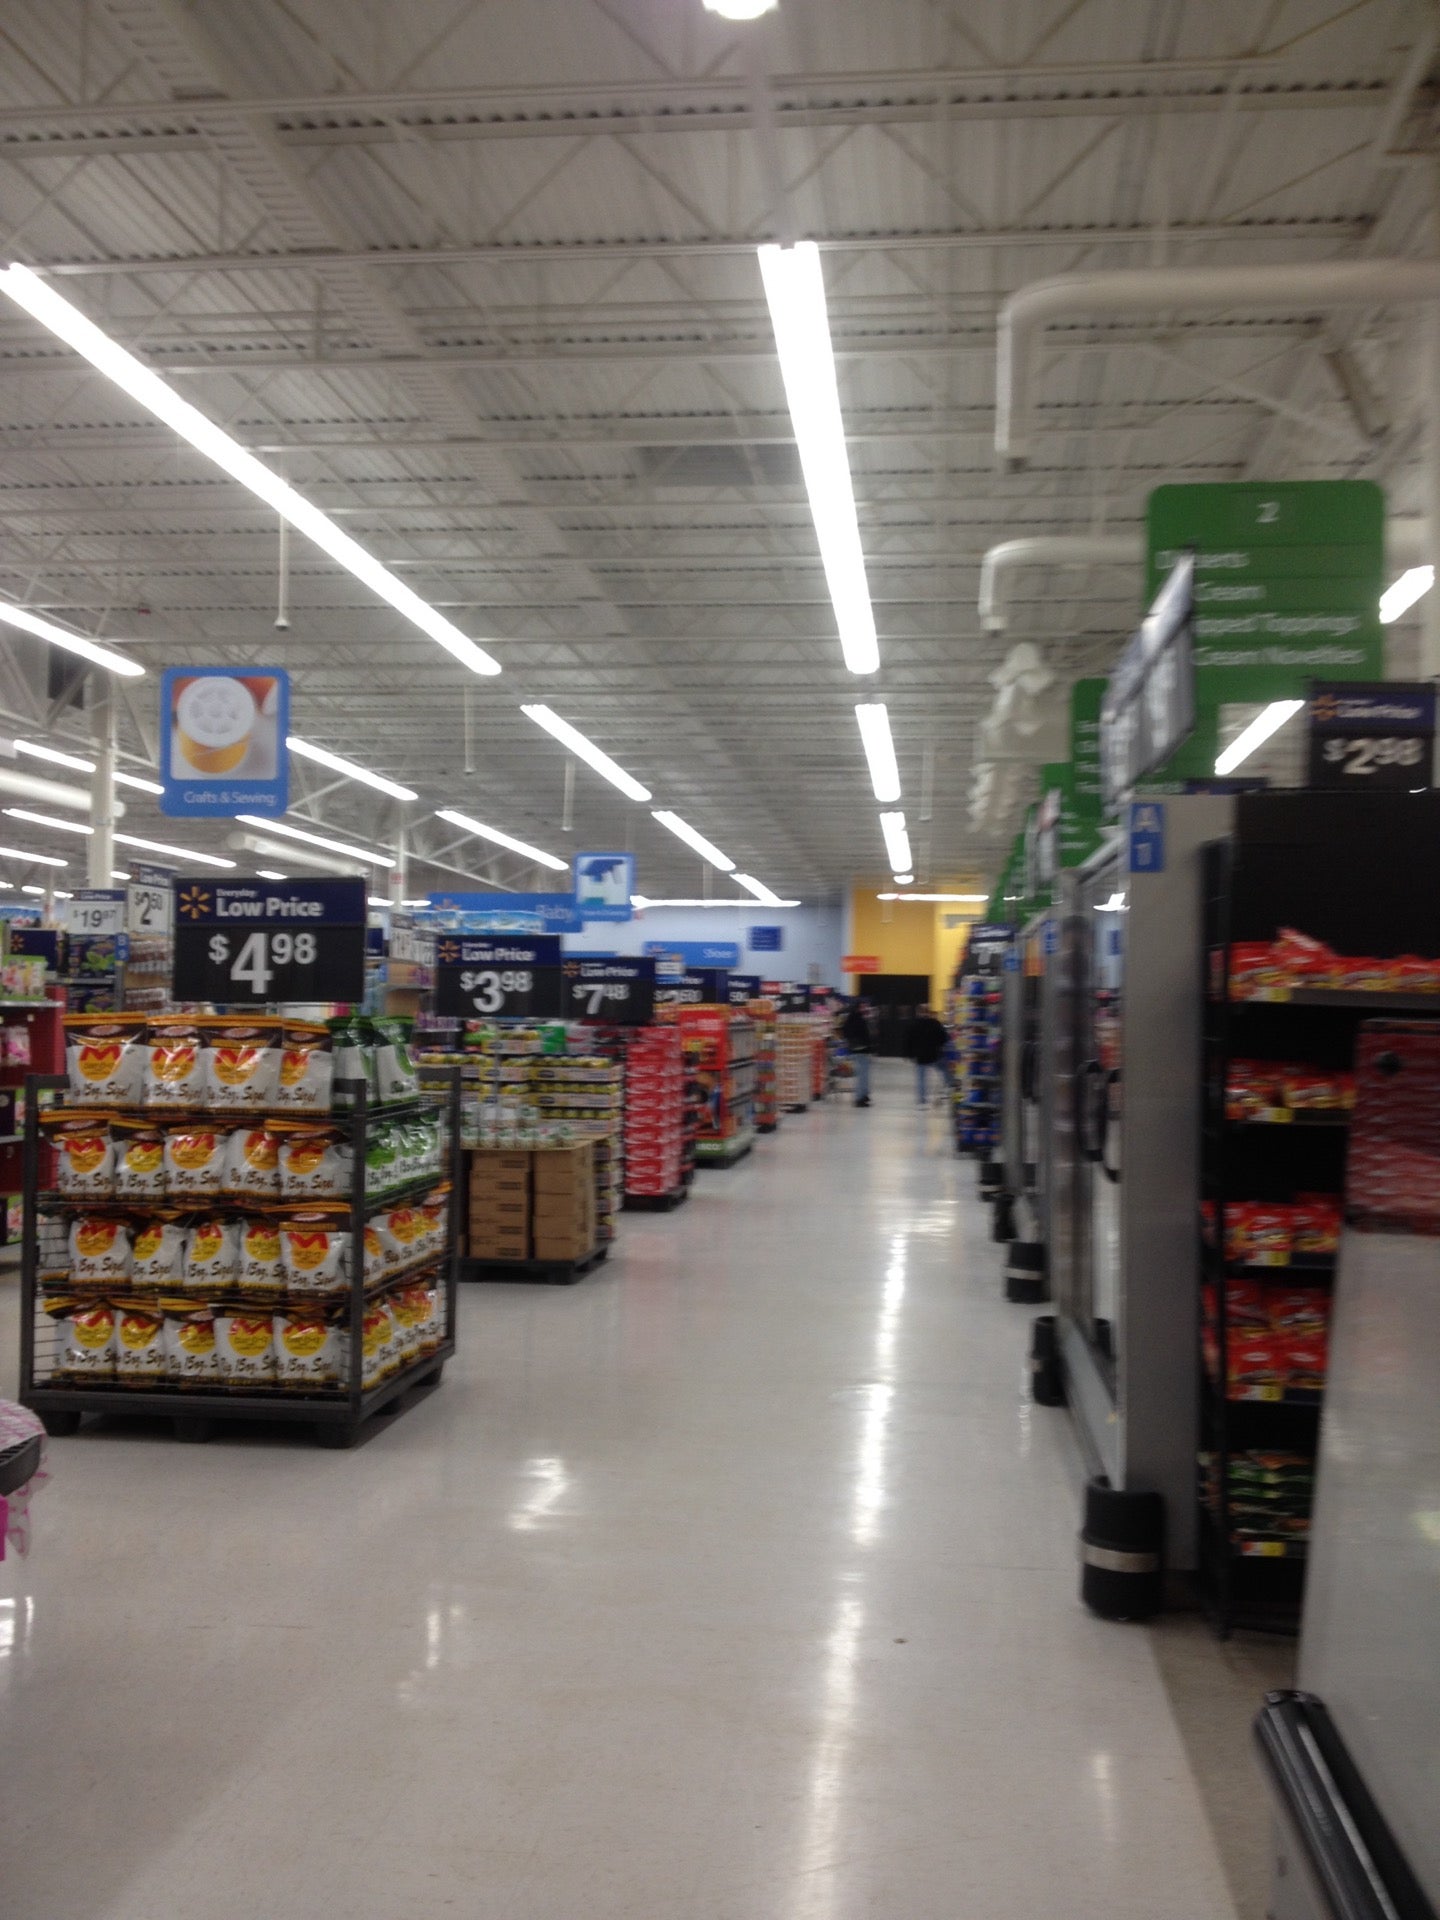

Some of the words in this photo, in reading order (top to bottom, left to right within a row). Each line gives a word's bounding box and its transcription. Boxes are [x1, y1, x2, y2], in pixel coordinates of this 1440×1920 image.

[1256, 501, 1280, 523] 2
[183, 791, 216, 804] Crafts
[220, 792, 230, 804] &
[231, 792, 276, 806] Sewing
[215, 898, 264, 918] Low
[266, 897, 324, 918] Price
[462, 948, 493, 962] Low
[494, 947, 537, 962] Price
